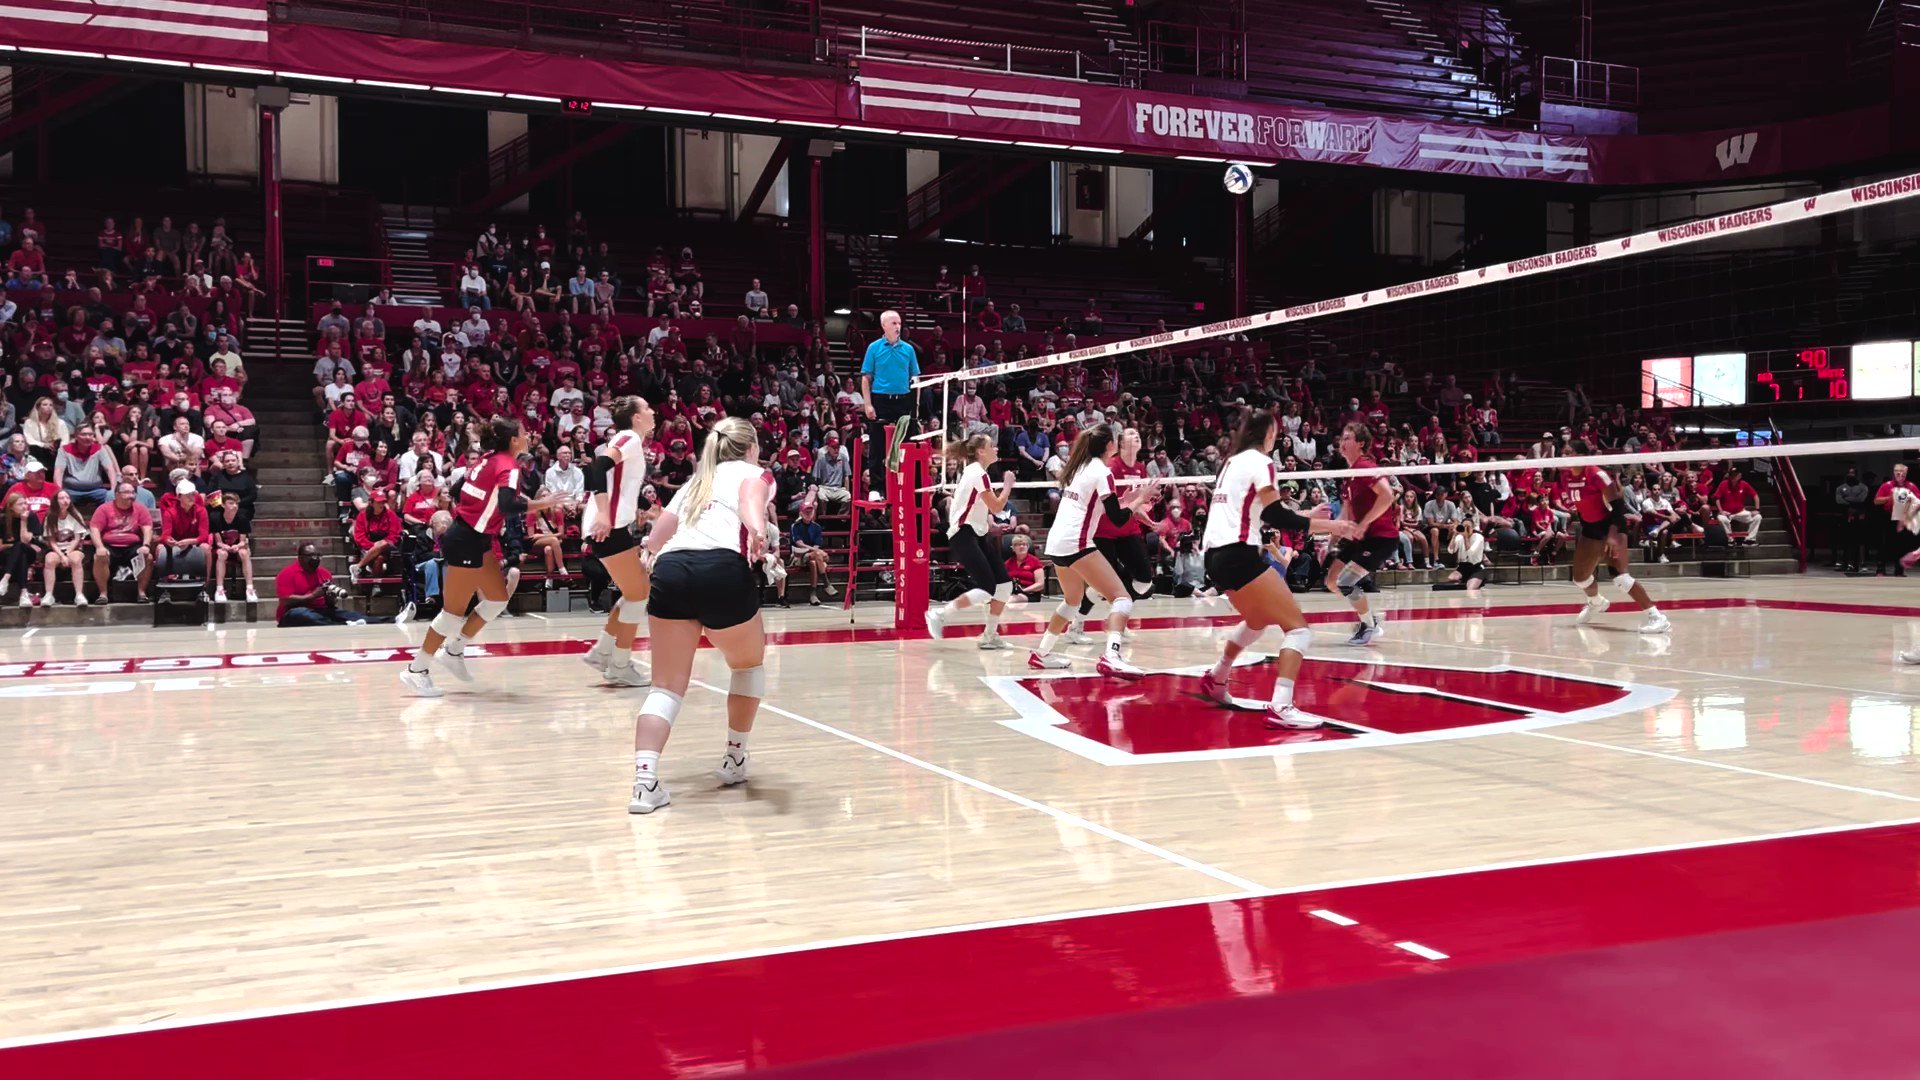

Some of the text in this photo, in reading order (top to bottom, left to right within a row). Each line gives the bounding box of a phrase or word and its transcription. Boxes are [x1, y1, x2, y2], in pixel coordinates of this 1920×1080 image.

[226, 86, 236, 98] Q
[1135, 102, 1373, 153] FOREVER FORWARD
[1715, 132, 1758, 171] W
[1657, 207, 1773, 243] WISCONSIN BADGERS
[1507, 245, 1598, 274] WISCONSIN BADGERS
[1769, 379, 1847, 400] 7 1 10
